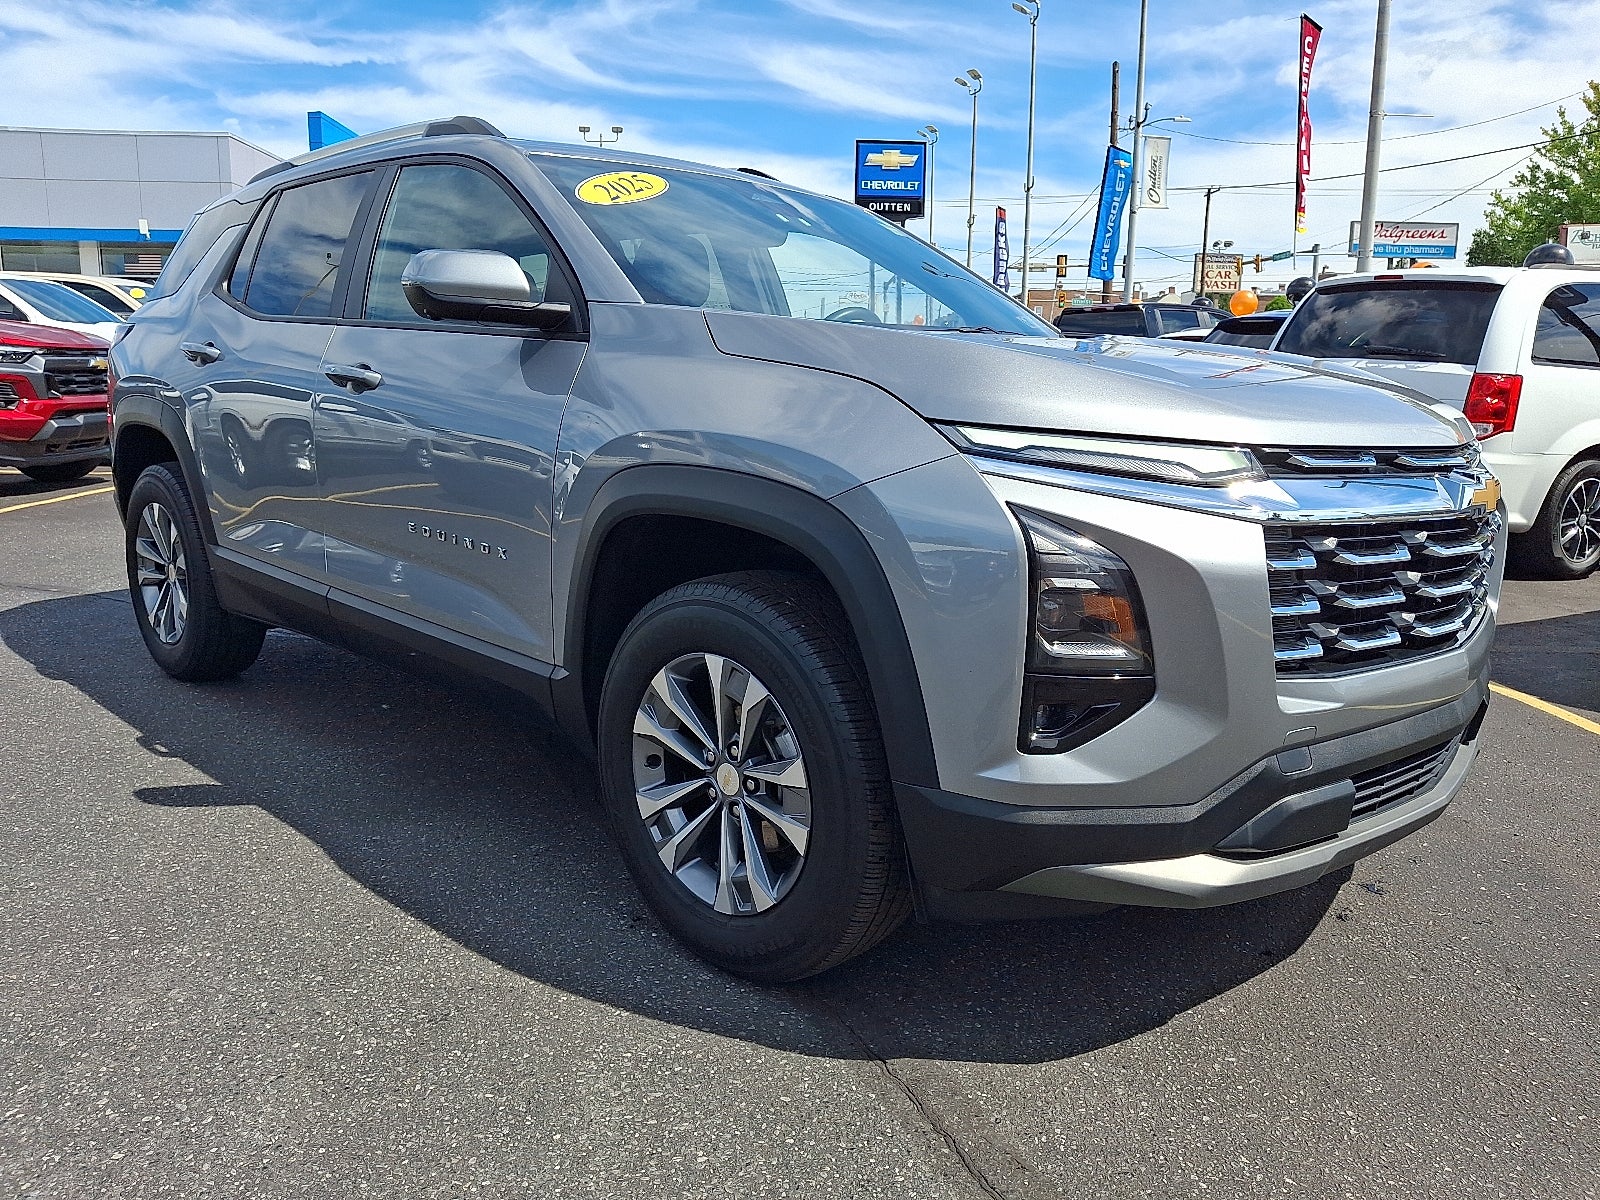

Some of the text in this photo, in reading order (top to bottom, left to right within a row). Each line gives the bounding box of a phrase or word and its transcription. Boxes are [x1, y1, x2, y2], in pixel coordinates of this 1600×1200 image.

[593, 174, 654, 202] 2025
[861, 180, 921, 190] CHEVROLET
[1146, 155, 1161, 204] Outten
[868, 202, 911, 211] OUTTEN
[1100, 169, 1126, 271] CHEVROLET
[997, 221, 1008, 286] RUCKS
[1385, 245, 1402, 253] thru
[1403, 246, 1445, 256] pharmacy
[1205, 270, 1232, 280] CAR
[1204, 280, 1238, 290] WASH
[407, 521, 508, 560] EQUINOX
